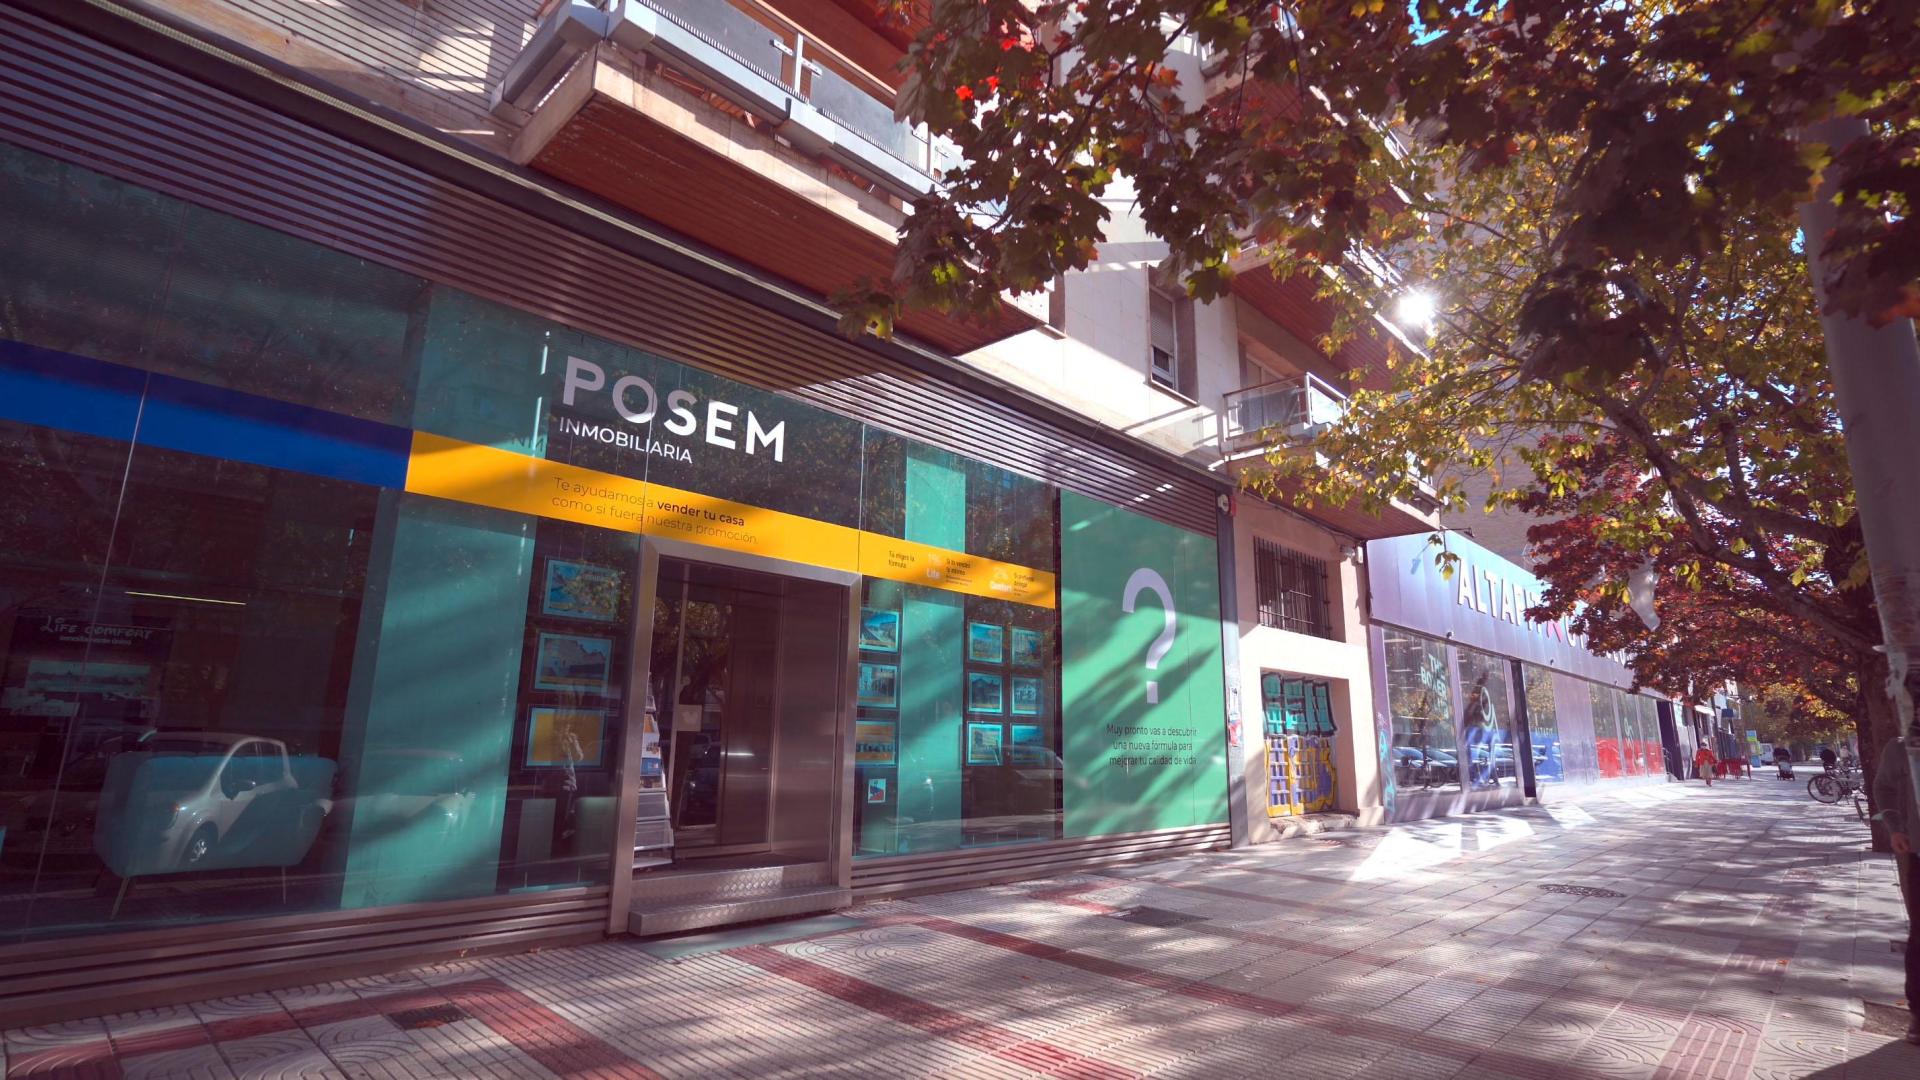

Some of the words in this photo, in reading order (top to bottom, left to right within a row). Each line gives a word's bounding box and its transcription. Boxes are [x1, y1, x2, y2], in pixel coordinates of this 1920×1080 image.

[562, 355, 785, 463] POSEM
[559, 416, 693, 464] INMOBILIARIA
[552, 497, 593, 512] como
[596, 505, 606, 515] si
[610, 505, 643, 522] fuera
[646, 515, 693, 532] nuestra
[554, 477, 570, 491] Te
[573, 483, 644, 506] ayudamos
[646, 500, 654, 508] a
[657, 500, 701, 517] vender
[703, 510, 716, 521] tu
[719, 513, 745, 526] casa
[1122, 567, 1177, 704] ?
[1106, 723, 1122, 737] Muy
[1124, 726, 1149, 736] pronto
[1150, 728, 1161, 736] vas
[1167, 727, 1198, 737] descubrir
[1112, 742, 1127, 750] una
[1128, 742, 1151, 751] nueva
[1178, 742, 1193, 752] para
[1109, 756, 1138, 767] mejorar
[1139, 756, 1147, 765] tu
[1148, 755, 1173, 765] calidad
[1174, 756, 1183, 765] de
[1183, 756, 1197, 765] vida
